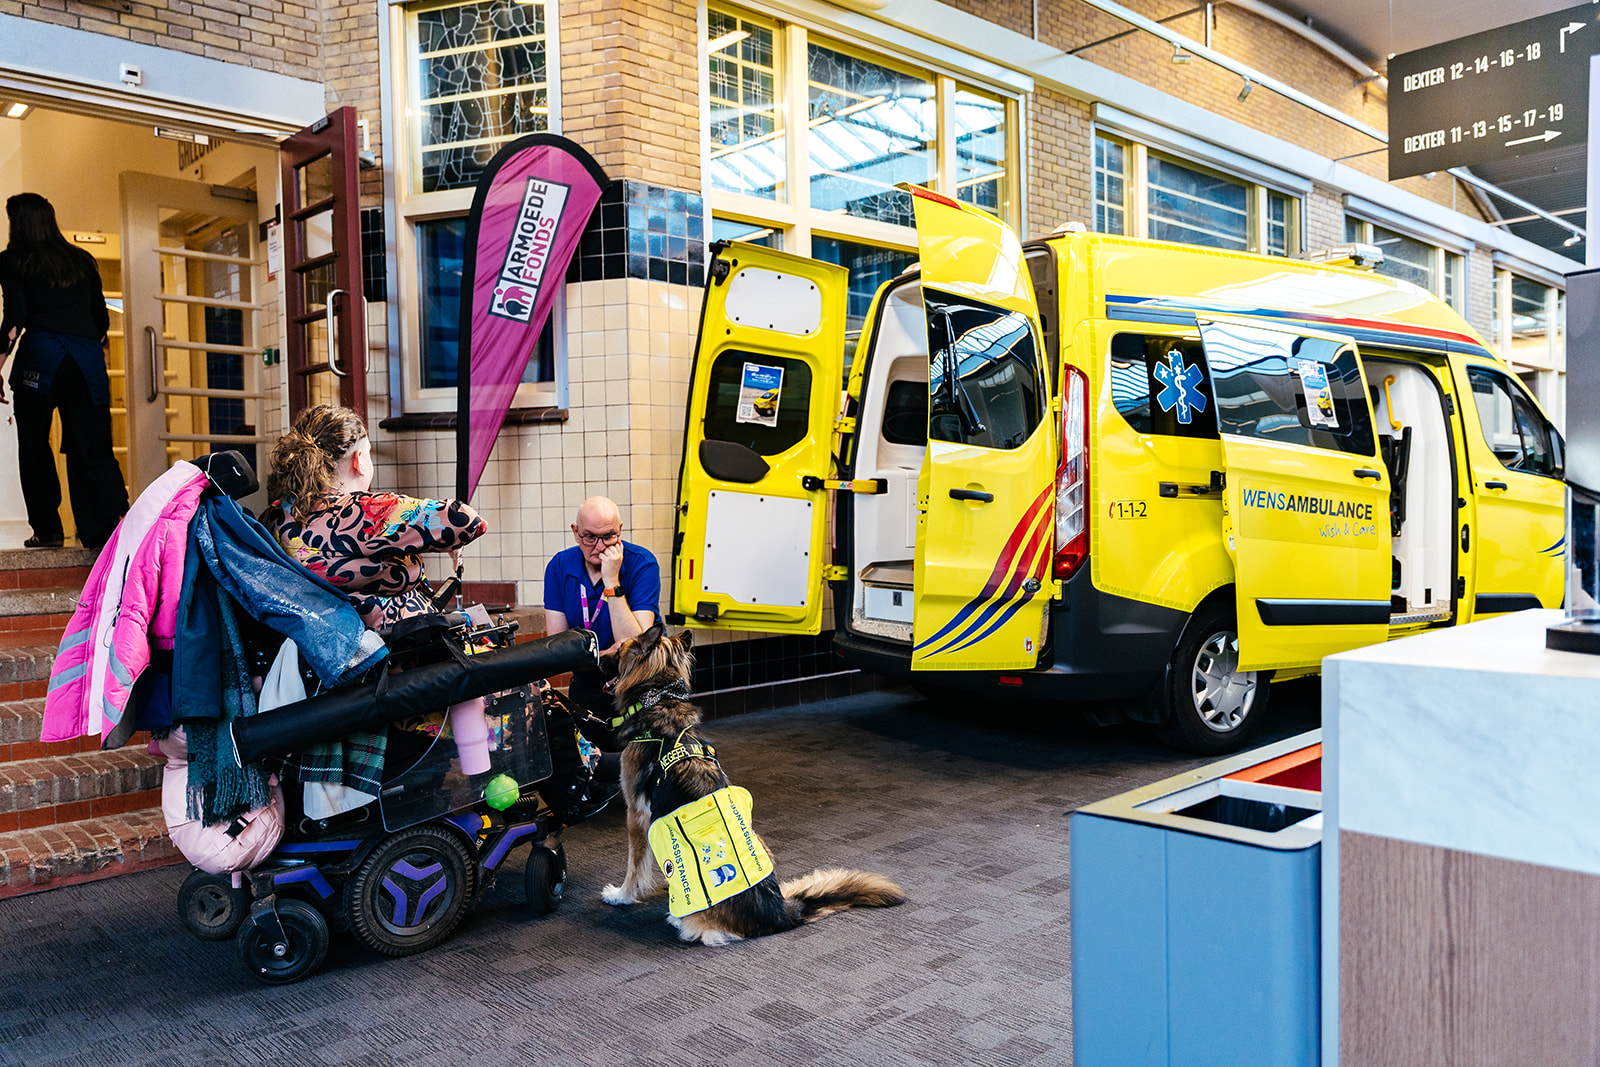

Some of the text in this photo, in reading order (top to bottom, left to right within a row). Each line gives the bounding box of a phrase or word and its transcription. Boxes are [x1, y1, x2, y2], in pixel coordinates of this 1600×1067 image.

[1403, 67, 1445, 93] DEXTER
[1404, 130, 1445, 154] DEXTER
[507, 182, 548, 279] ARMOEDE
[522, 217, 555, 282] FONDS
[1117, 502, 1147, 518] 1-1-2
[1243, 488, 1373, 520] WENSAMBULANCE
[1343, 523, 1350, 536] &
[1352, 522, 1376, 537] Care
[730, 804, 757, 857] ASSISTANCE
[671, 837, 692, 894] ASSISTANCE
